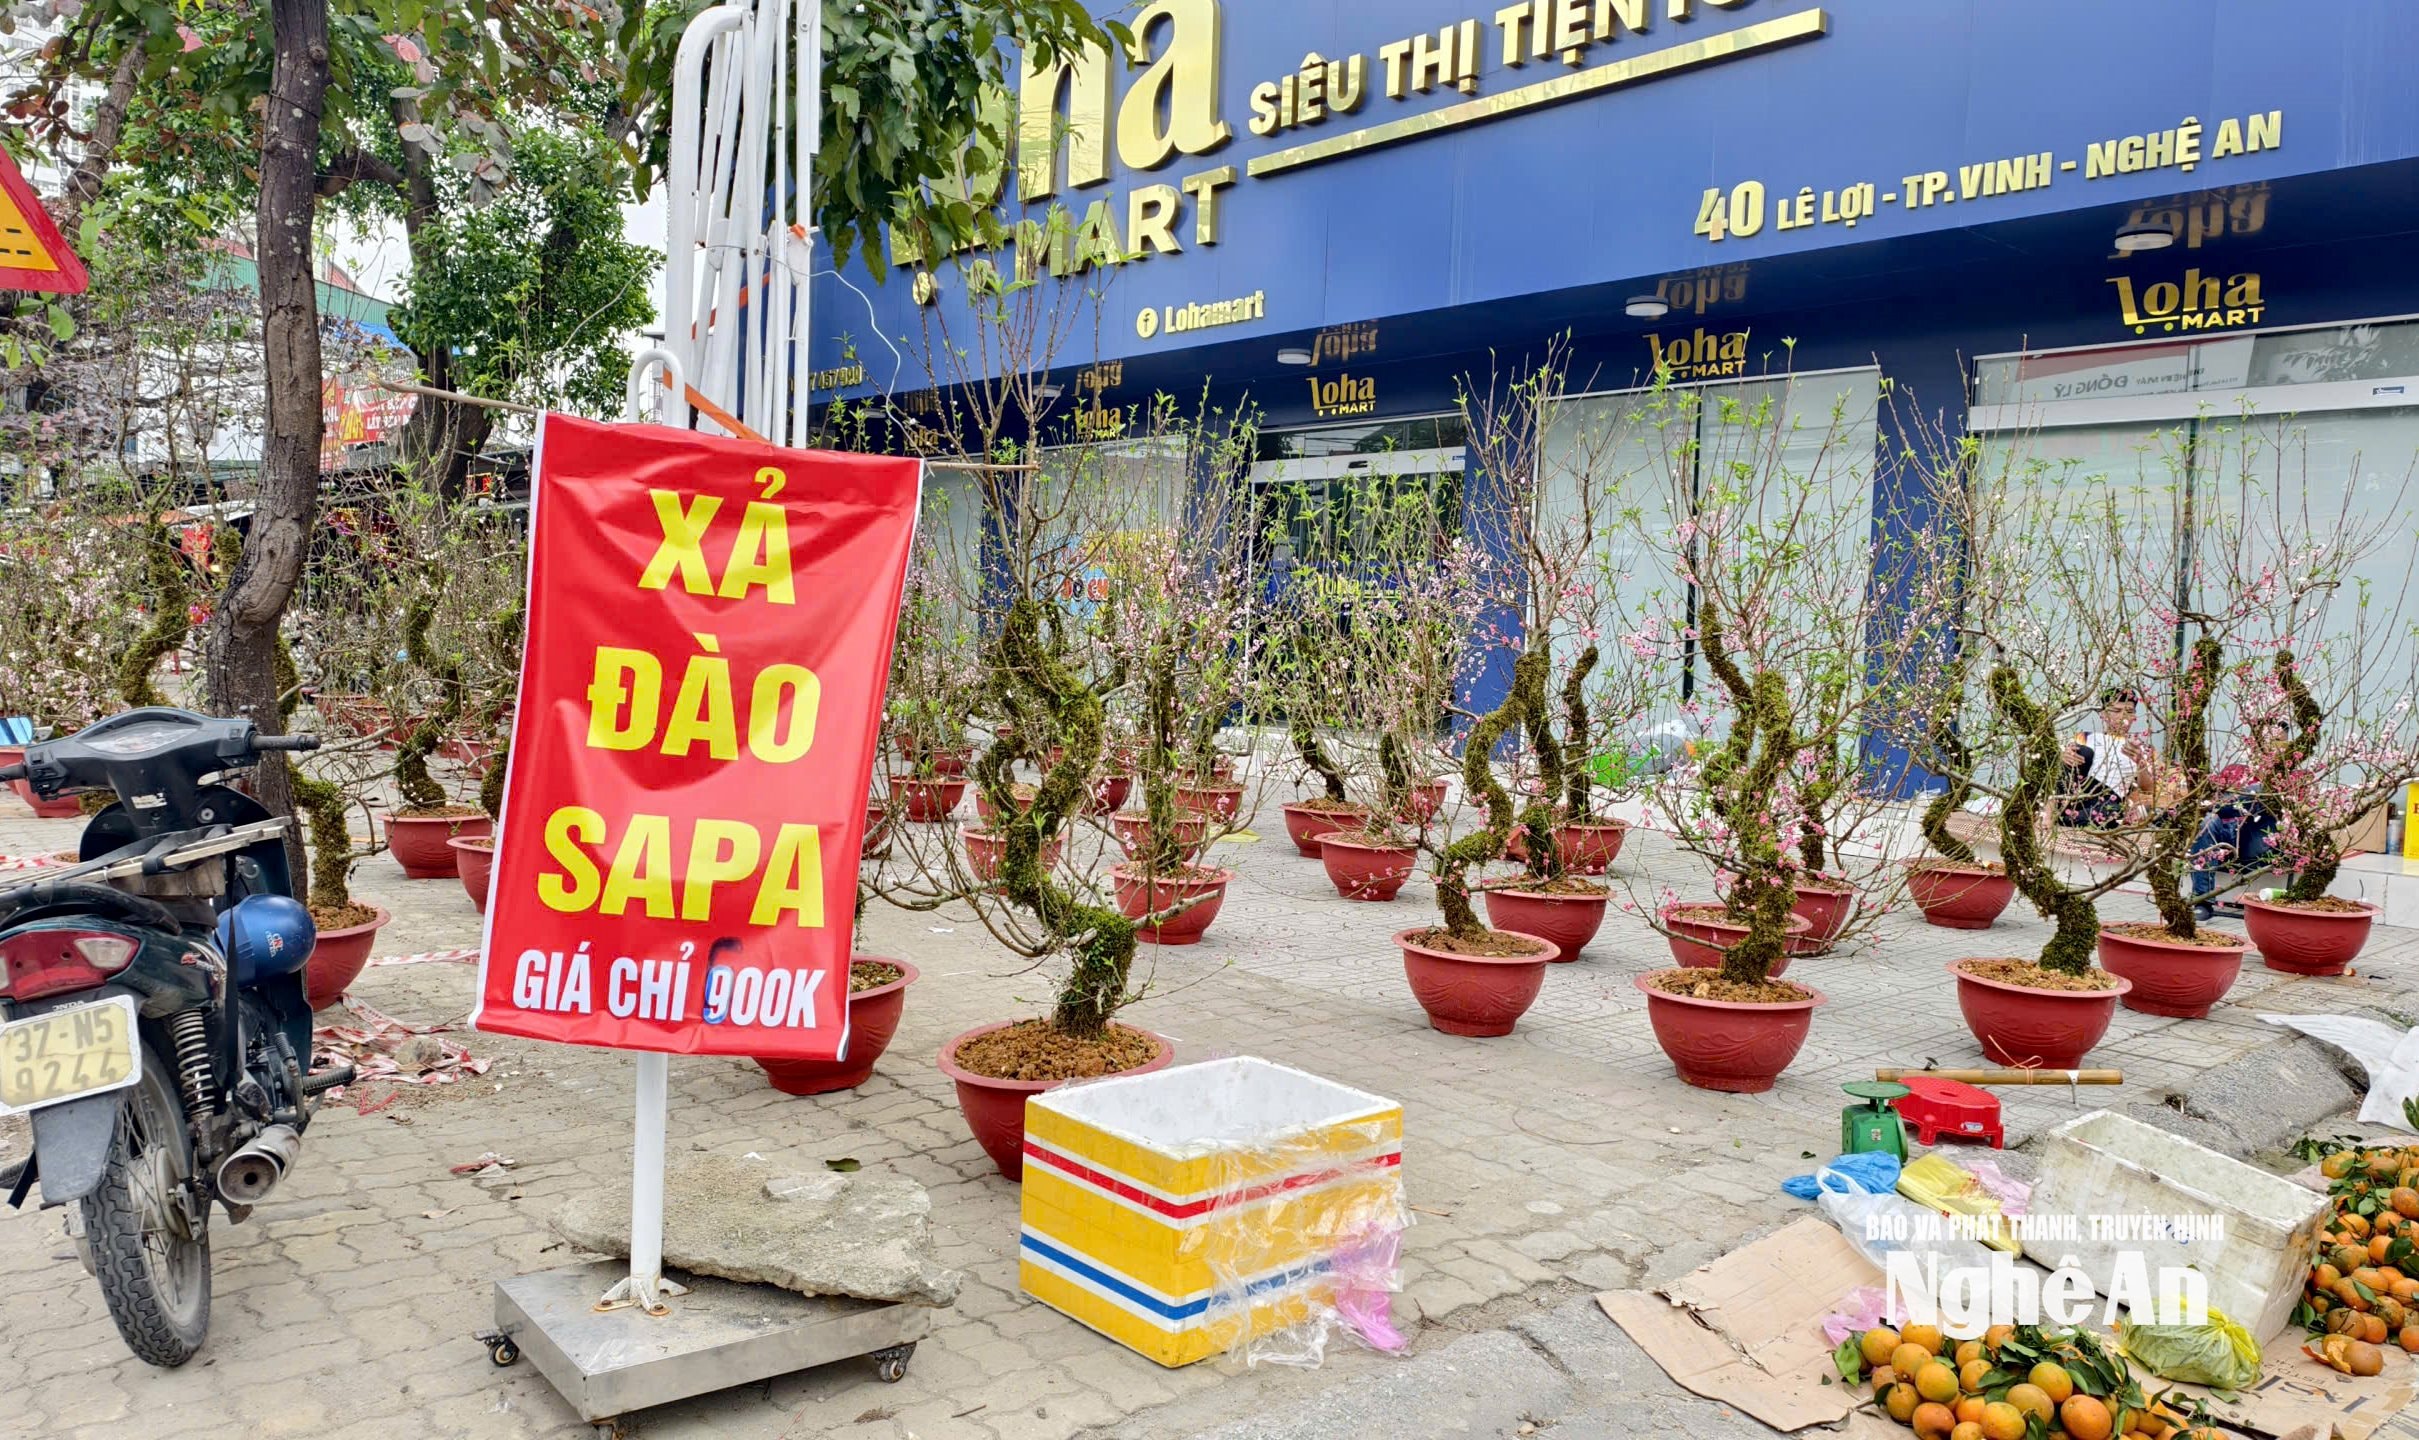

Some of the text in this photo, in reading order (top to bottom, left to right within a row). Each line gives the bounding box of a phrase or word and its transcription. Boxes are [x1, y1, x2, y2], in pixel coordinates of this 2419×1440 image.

[1248, 51, 1366, 136] SIÊU
[1379, 18, 1481, 99] THỊ
[1694, 180, 1765, 241] 40
[1776, 186, 1816, 231] LÊ
[1822, 182, 1875, 228] LỢI
[2085, 116, 2202, 179] NGHỆ
[2212, 110, 2283, 158] AN
[1164, 289, 1265, 333] Lohamart
[2181, 306, 2265, 330] MART
[1338, 401, 1377, 415] MART
[1692, 360, 1746, 377] MART
[637, 466, 796, 605] XẢ
[586, 632, 821, 763] ĐÀO
[537, 805, 825, 928] SAPA
[512, 941, 593, 1014] GIÁ
[607, 940, 695, 1022] CHỈ
[15, 1048, 118, 1099] 9244
